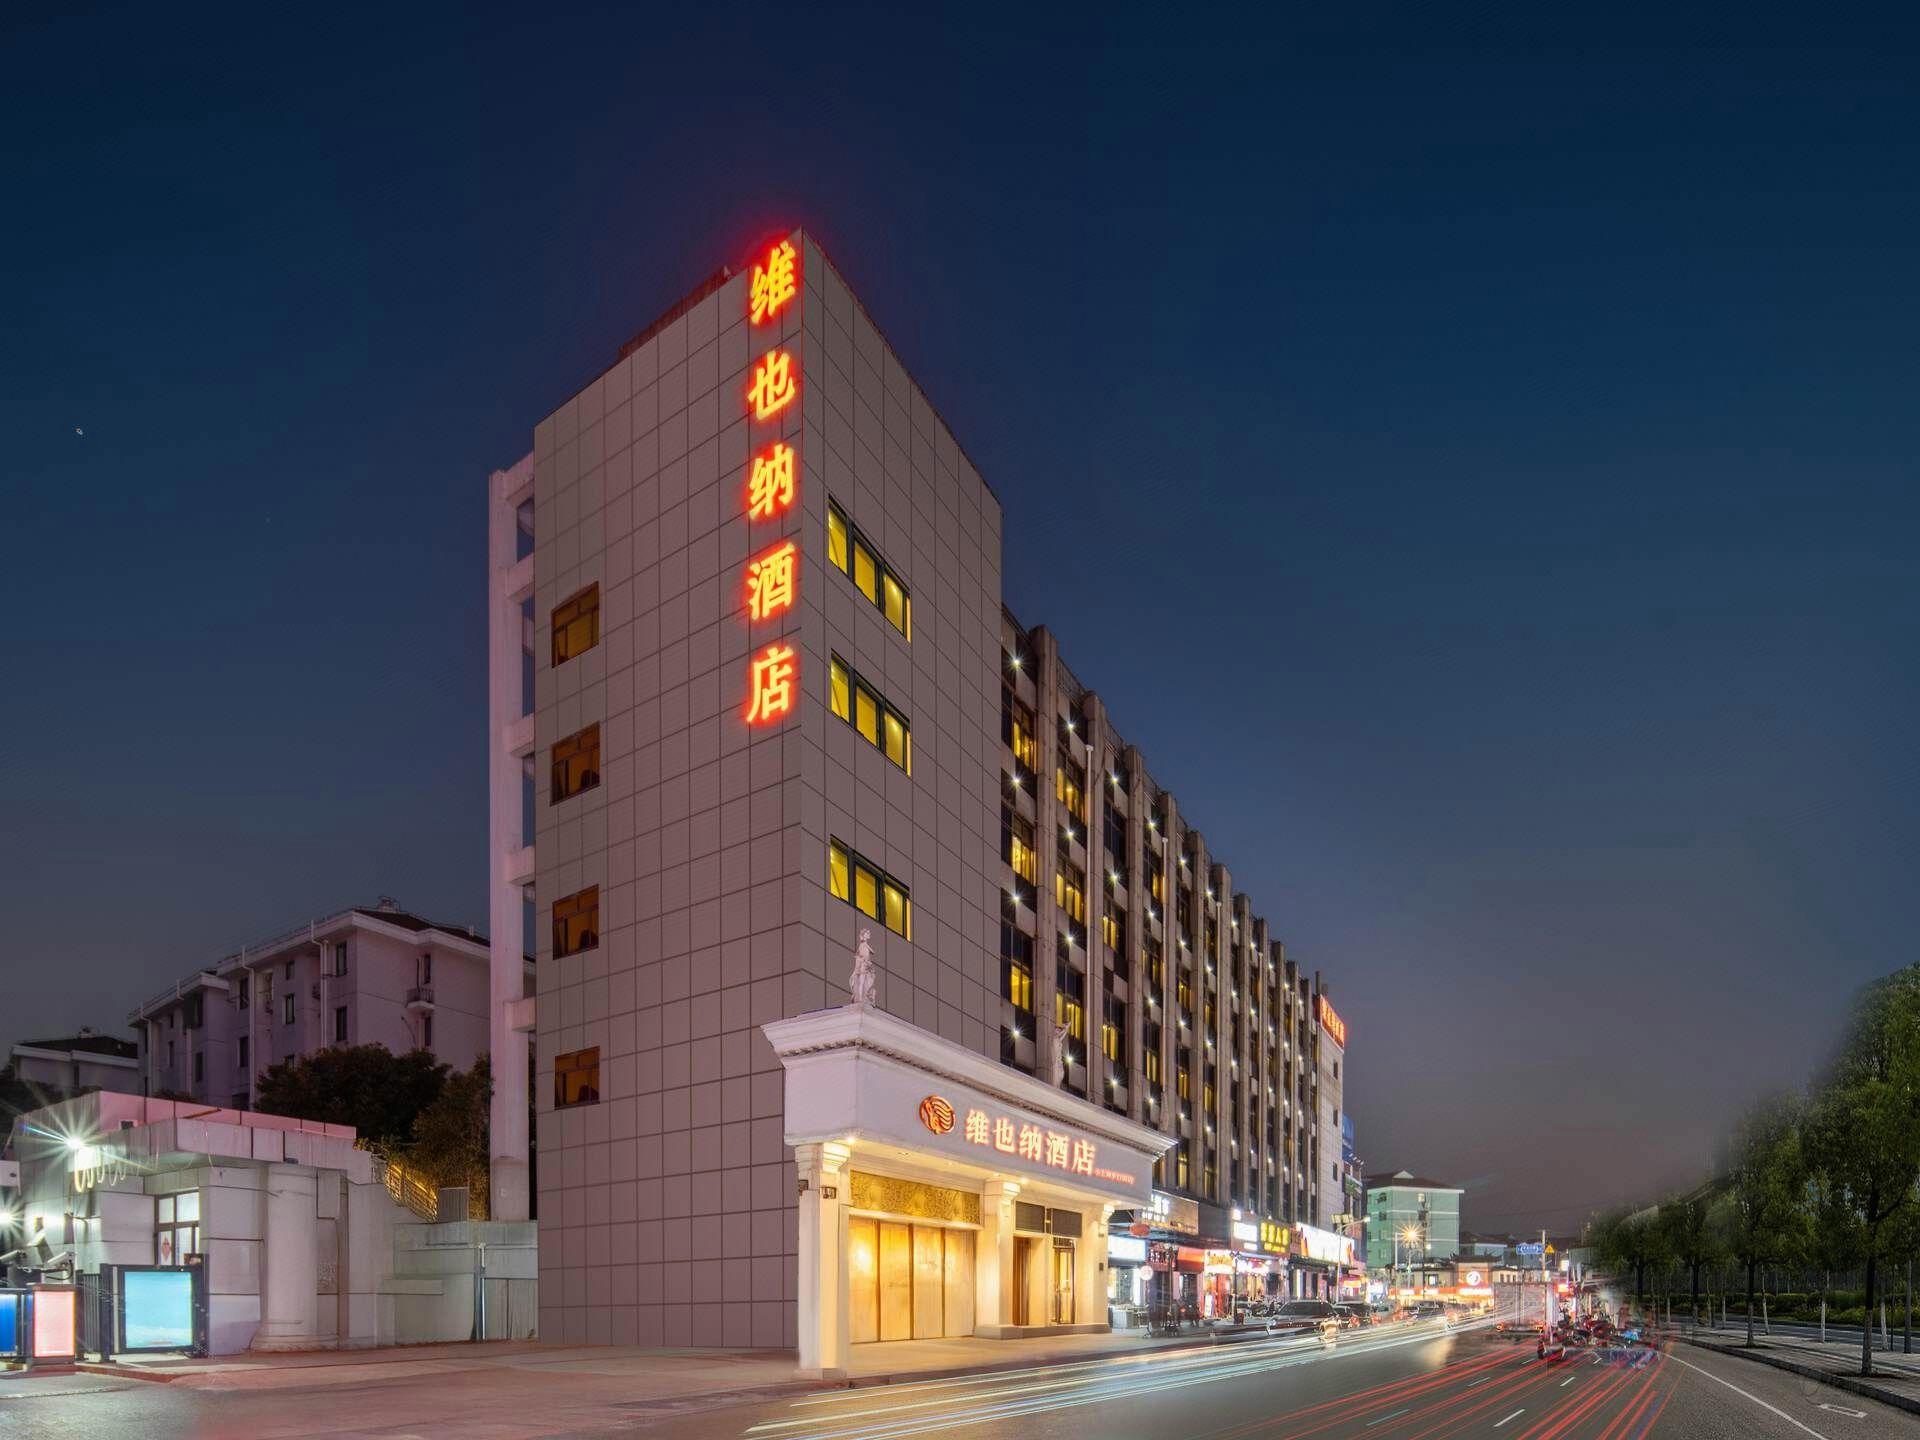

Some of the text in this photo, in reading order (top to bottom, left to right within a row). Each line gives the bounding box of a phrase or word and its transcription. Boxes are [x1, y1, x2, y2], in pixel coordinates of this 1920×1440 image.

[748, 240, 797, 723] 维也纳酒店
[965, 1109, 1096, 1176] 维也纳酒店
